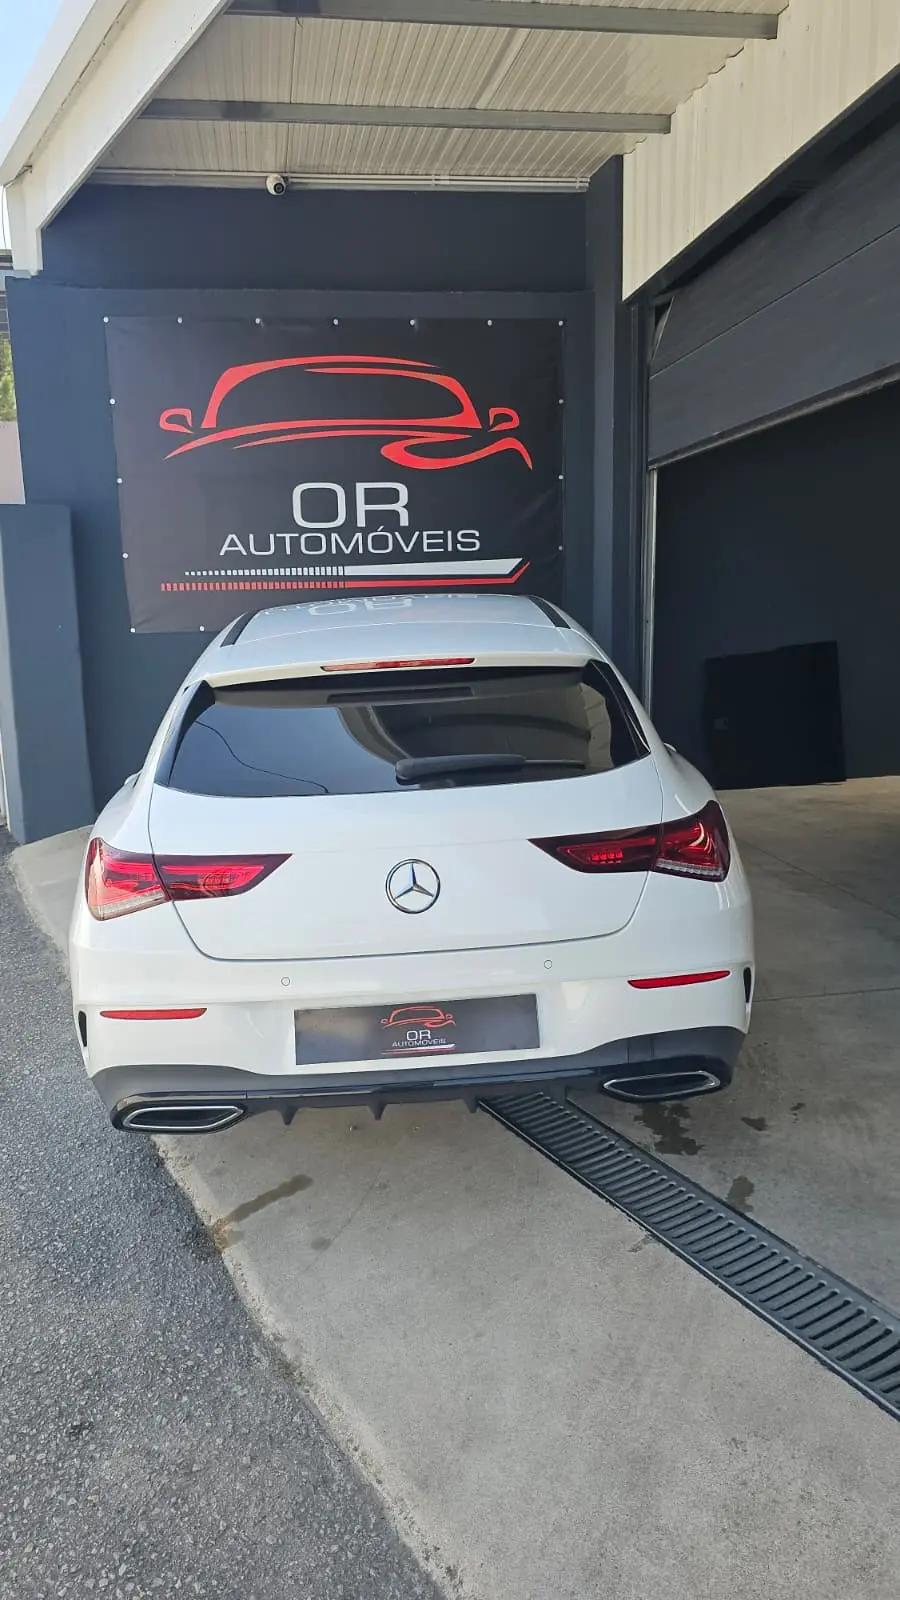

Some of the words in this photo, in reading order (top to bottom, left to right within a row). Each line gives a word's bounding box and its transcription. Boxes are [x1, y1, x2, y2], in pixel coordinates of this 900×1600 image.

[292, 482, 409, 528] OR
[219, 526, 481, 556] AUTOMÓVEIS
[406, 1029, 431, 1040] OR
